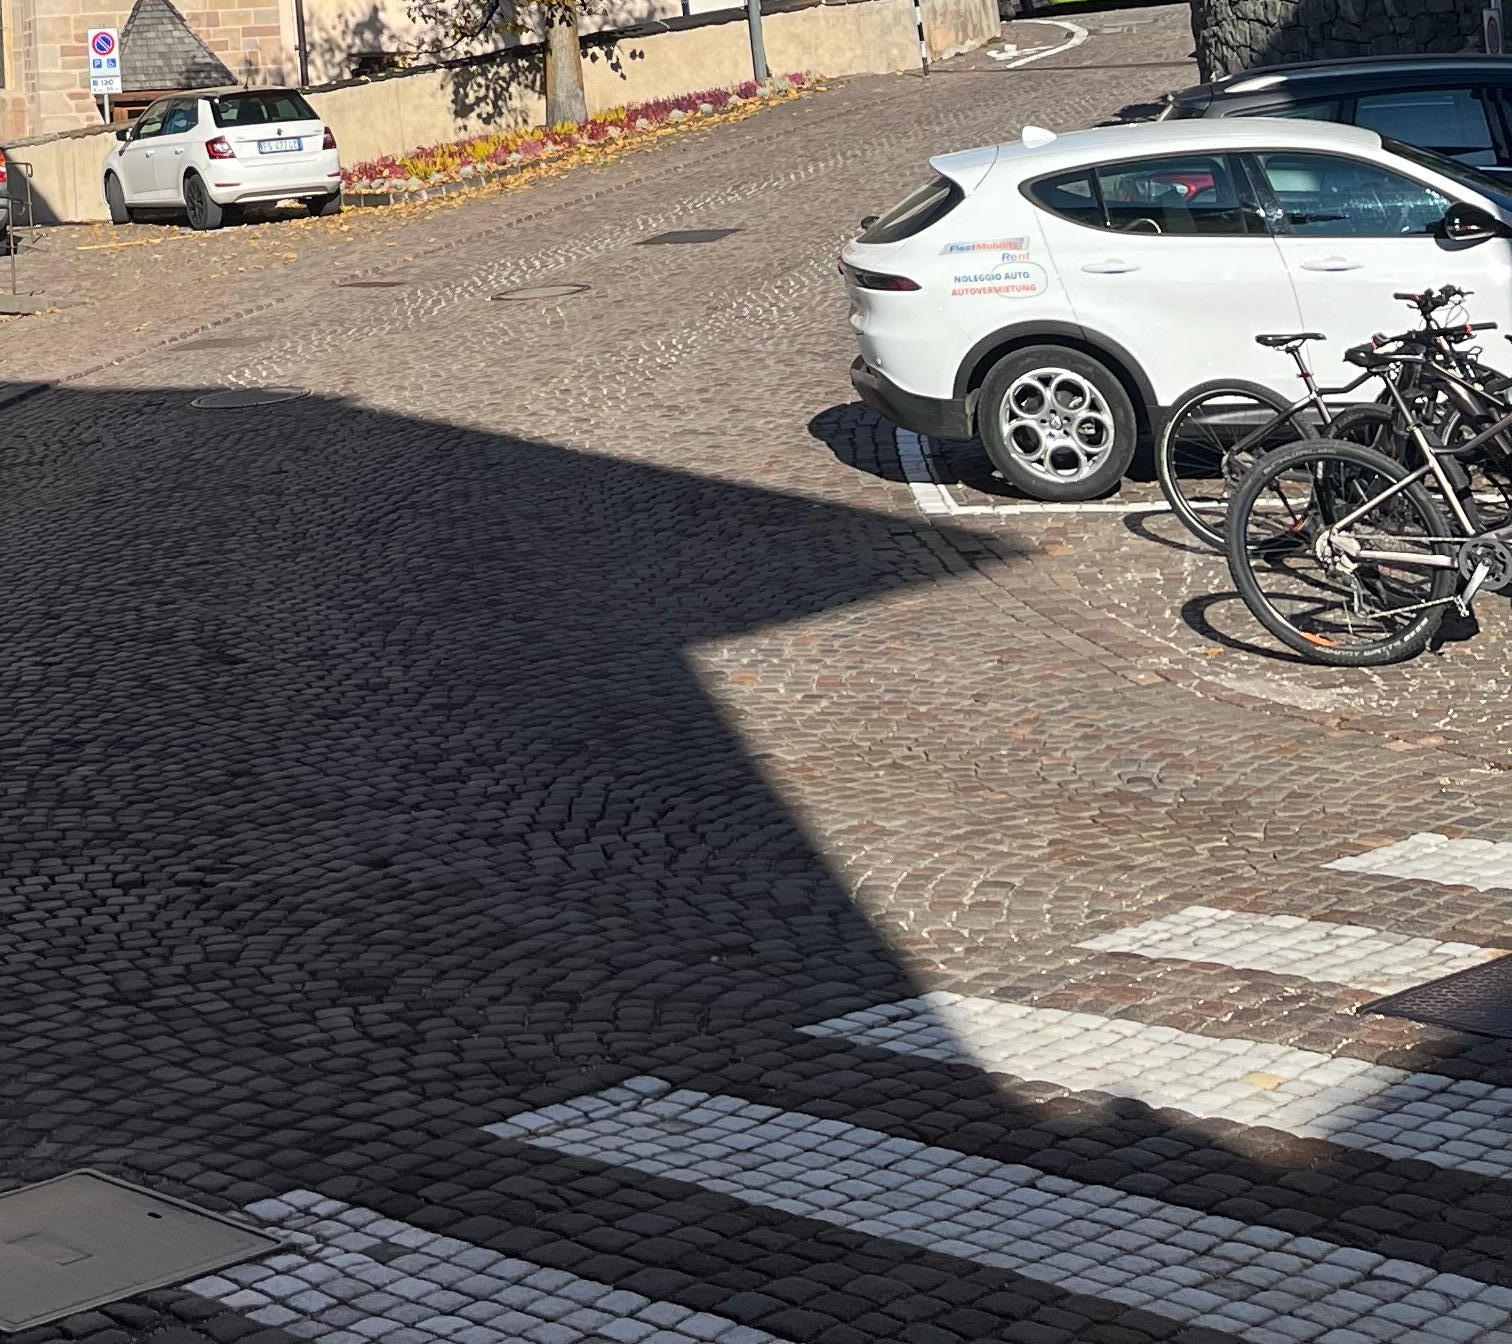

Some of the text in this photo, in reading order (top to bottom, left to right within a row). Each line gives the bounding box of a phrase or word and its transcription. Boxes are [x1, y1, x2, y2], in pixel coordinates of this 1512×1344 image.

[1001, 252, 1031, 262] Rent
[954, 271, 1030, 284] NOLEGGIO AUTO
[951, 283, 1037, 297] AUTOVERMIETUNG
